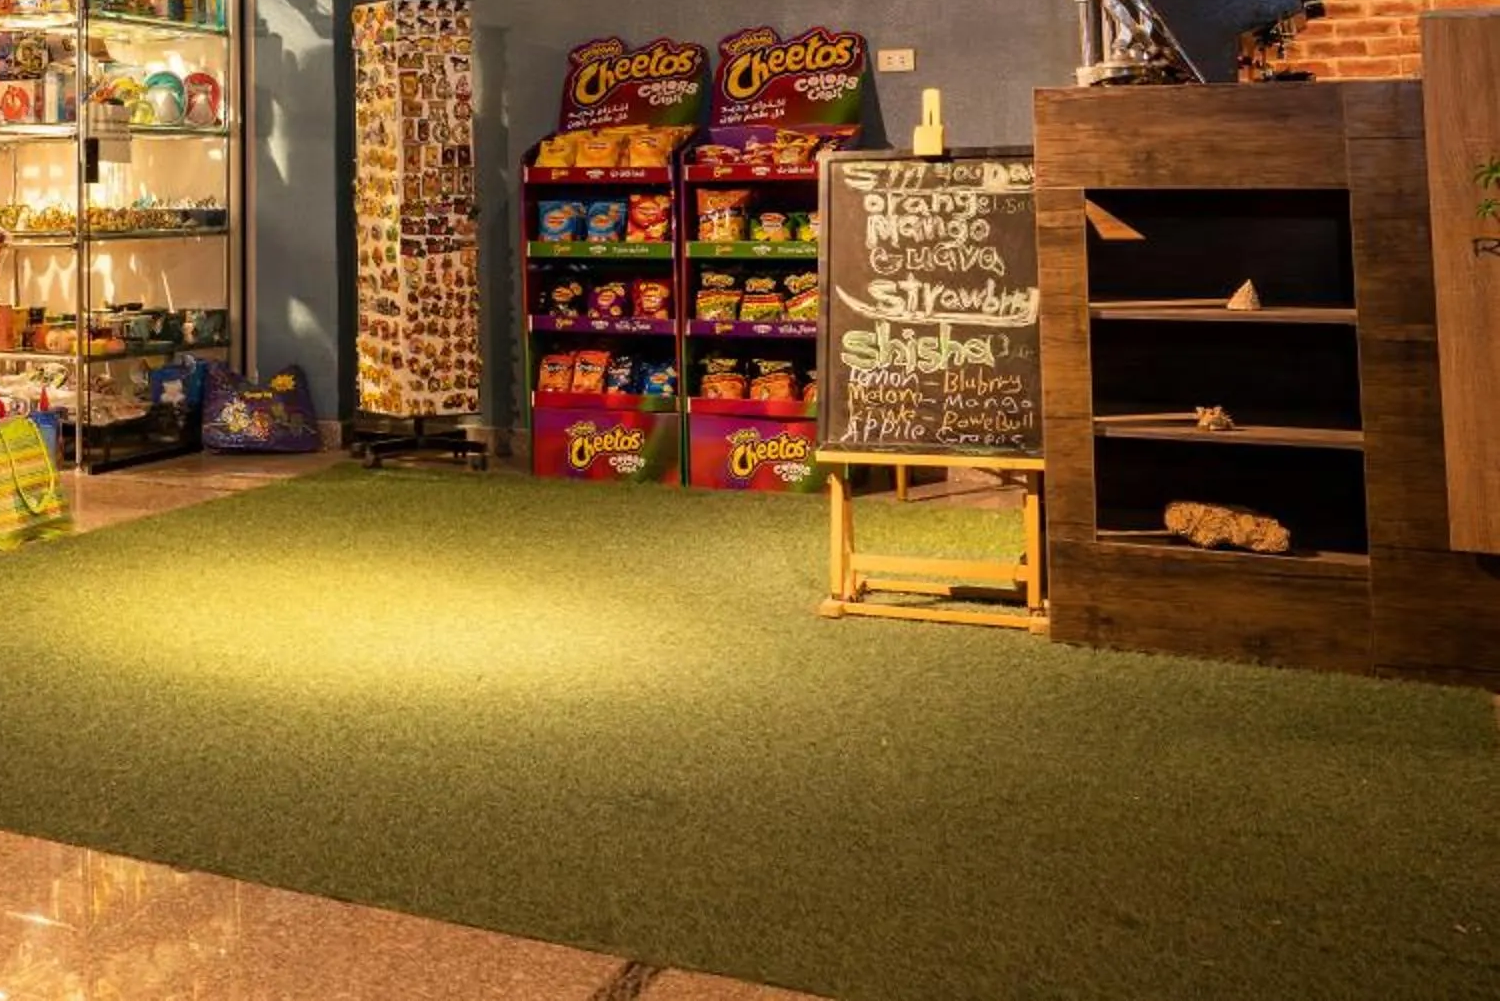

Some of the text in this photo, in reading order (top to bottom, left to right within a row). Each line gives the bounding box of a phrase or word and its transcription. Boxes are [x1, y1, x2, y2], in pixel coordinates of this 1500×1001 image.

[575, 46, 692, 106] Cheetos
[727, 32, 855, 100] Cheetos
[570, 426, 642, 468] Cheetos
[731, 435, 807, 477] Cheetos
